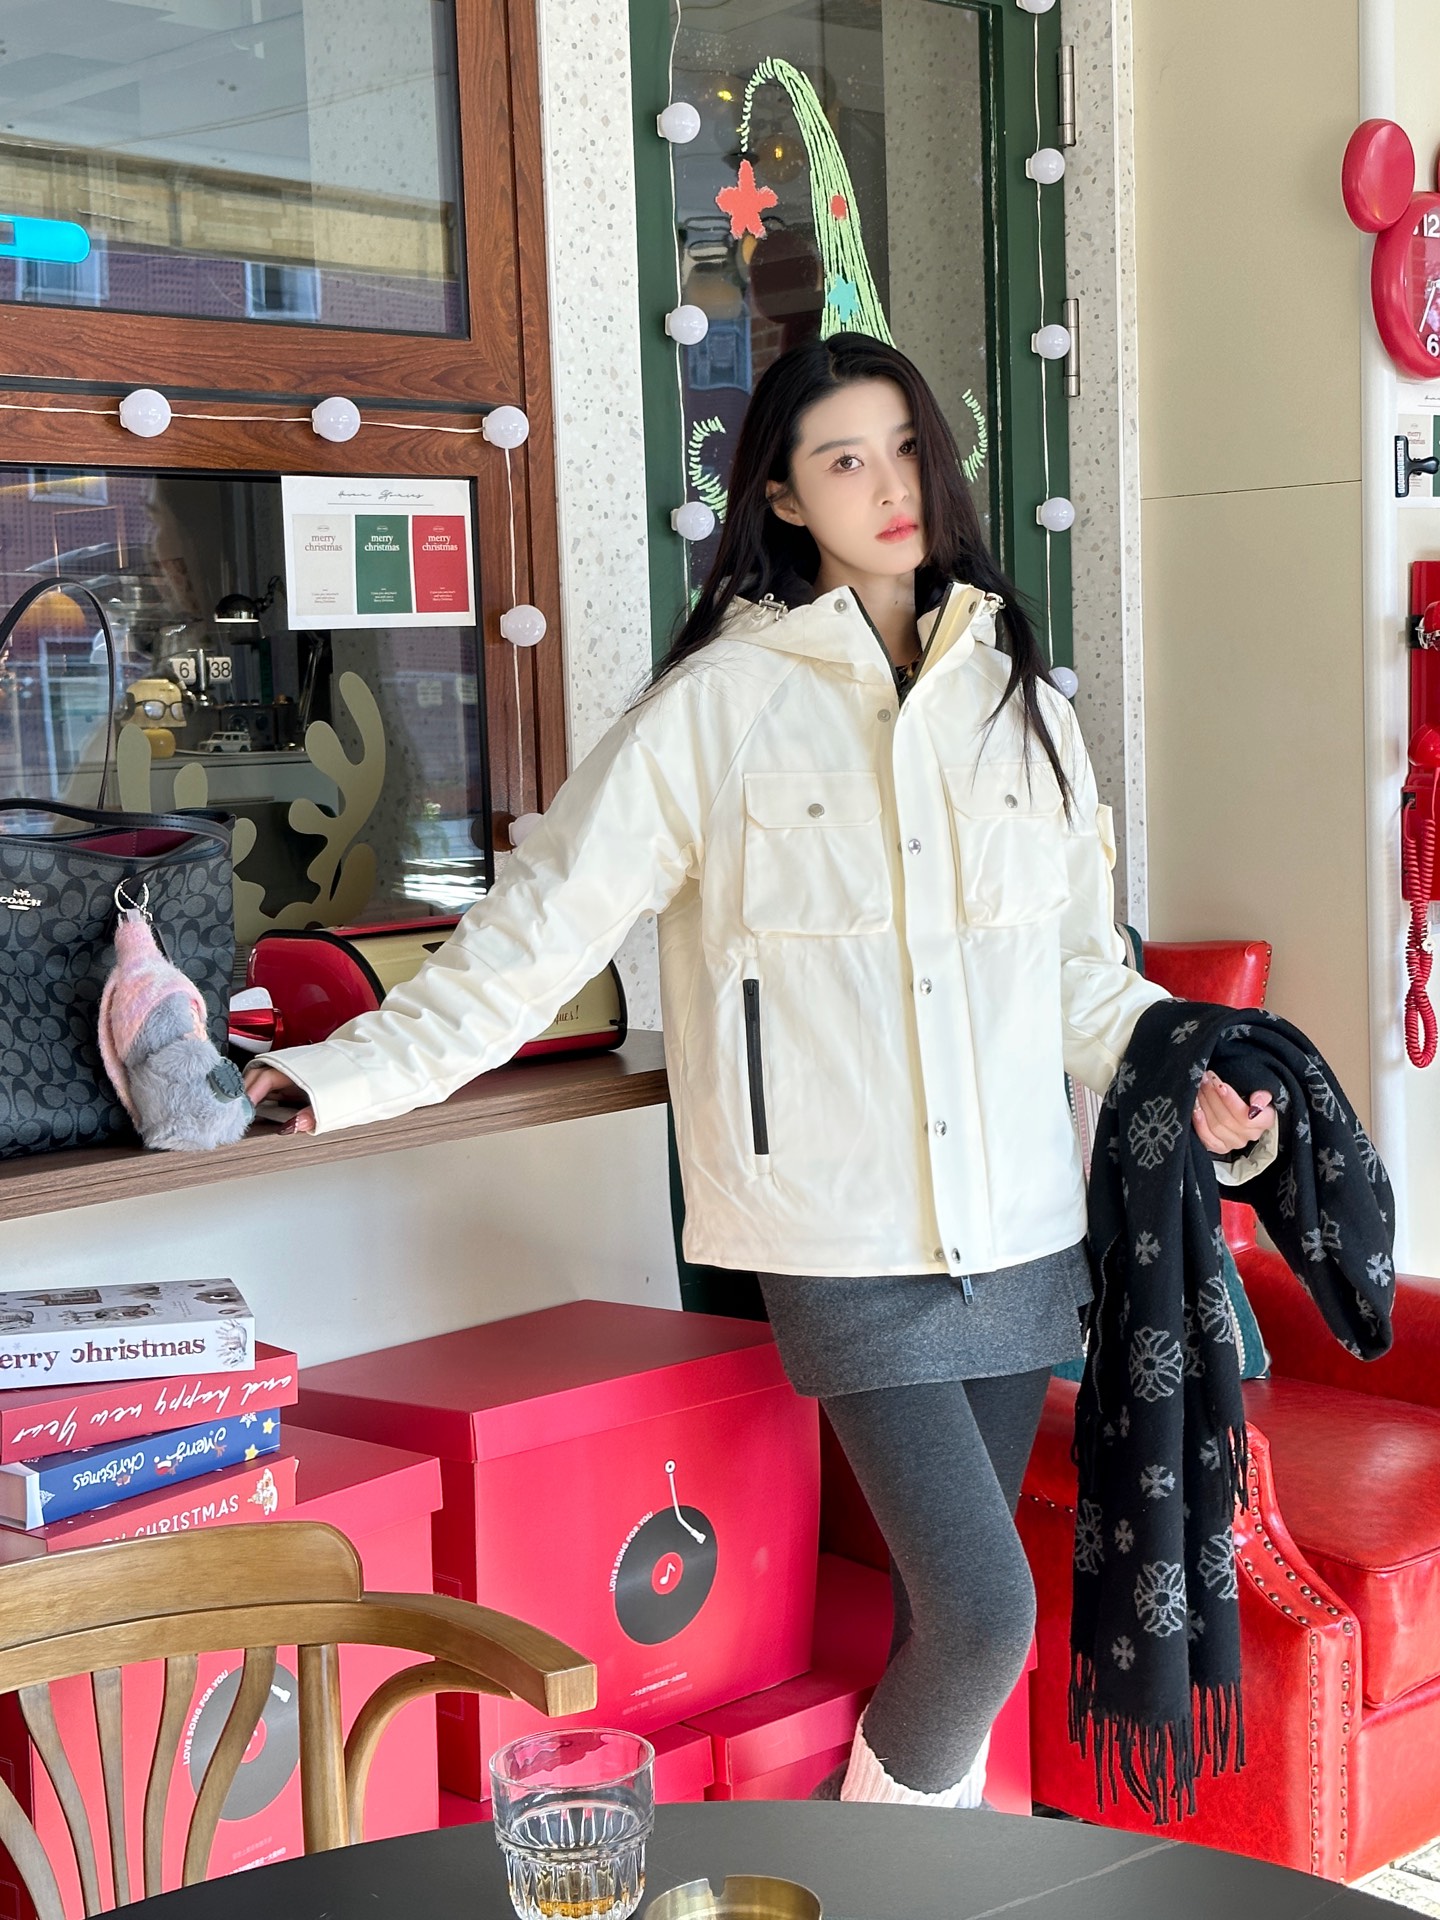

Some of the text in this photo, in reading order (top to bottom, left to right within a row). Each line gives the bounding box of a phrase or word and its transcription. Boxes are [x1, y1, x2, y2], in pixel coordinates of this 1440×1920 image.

[1423, 213, 1440, 237] 12
[1426, 333, 1439, 357] 6
[304, 542, 342, 551] christmas
[311, 534, 336, 543] merry
[364, 542, 400, 551] christmas
[371, 534, 394, 543] merry
[422, 542, 458, 551] christmas
[428, 534, 451, 543] merry
[179, 661, 190, 679] 6
[211, 661, 231, 678] 38
[0, 896, 42, 907] COACH
[154, 1380, 230, 1415] happy
[241, 1375, 292, 1406] and
[89, 1403, 143, 1425] new
[72, 1427, 227, 1491] Merry Christmas
[134, 1494, 240, 1536] CHRISTMAS
[609, 1511, 654, 1592] LOVE SONG FOR YOU
[183, 1669, 229, 1766] LOVE SONG FOR YOU
